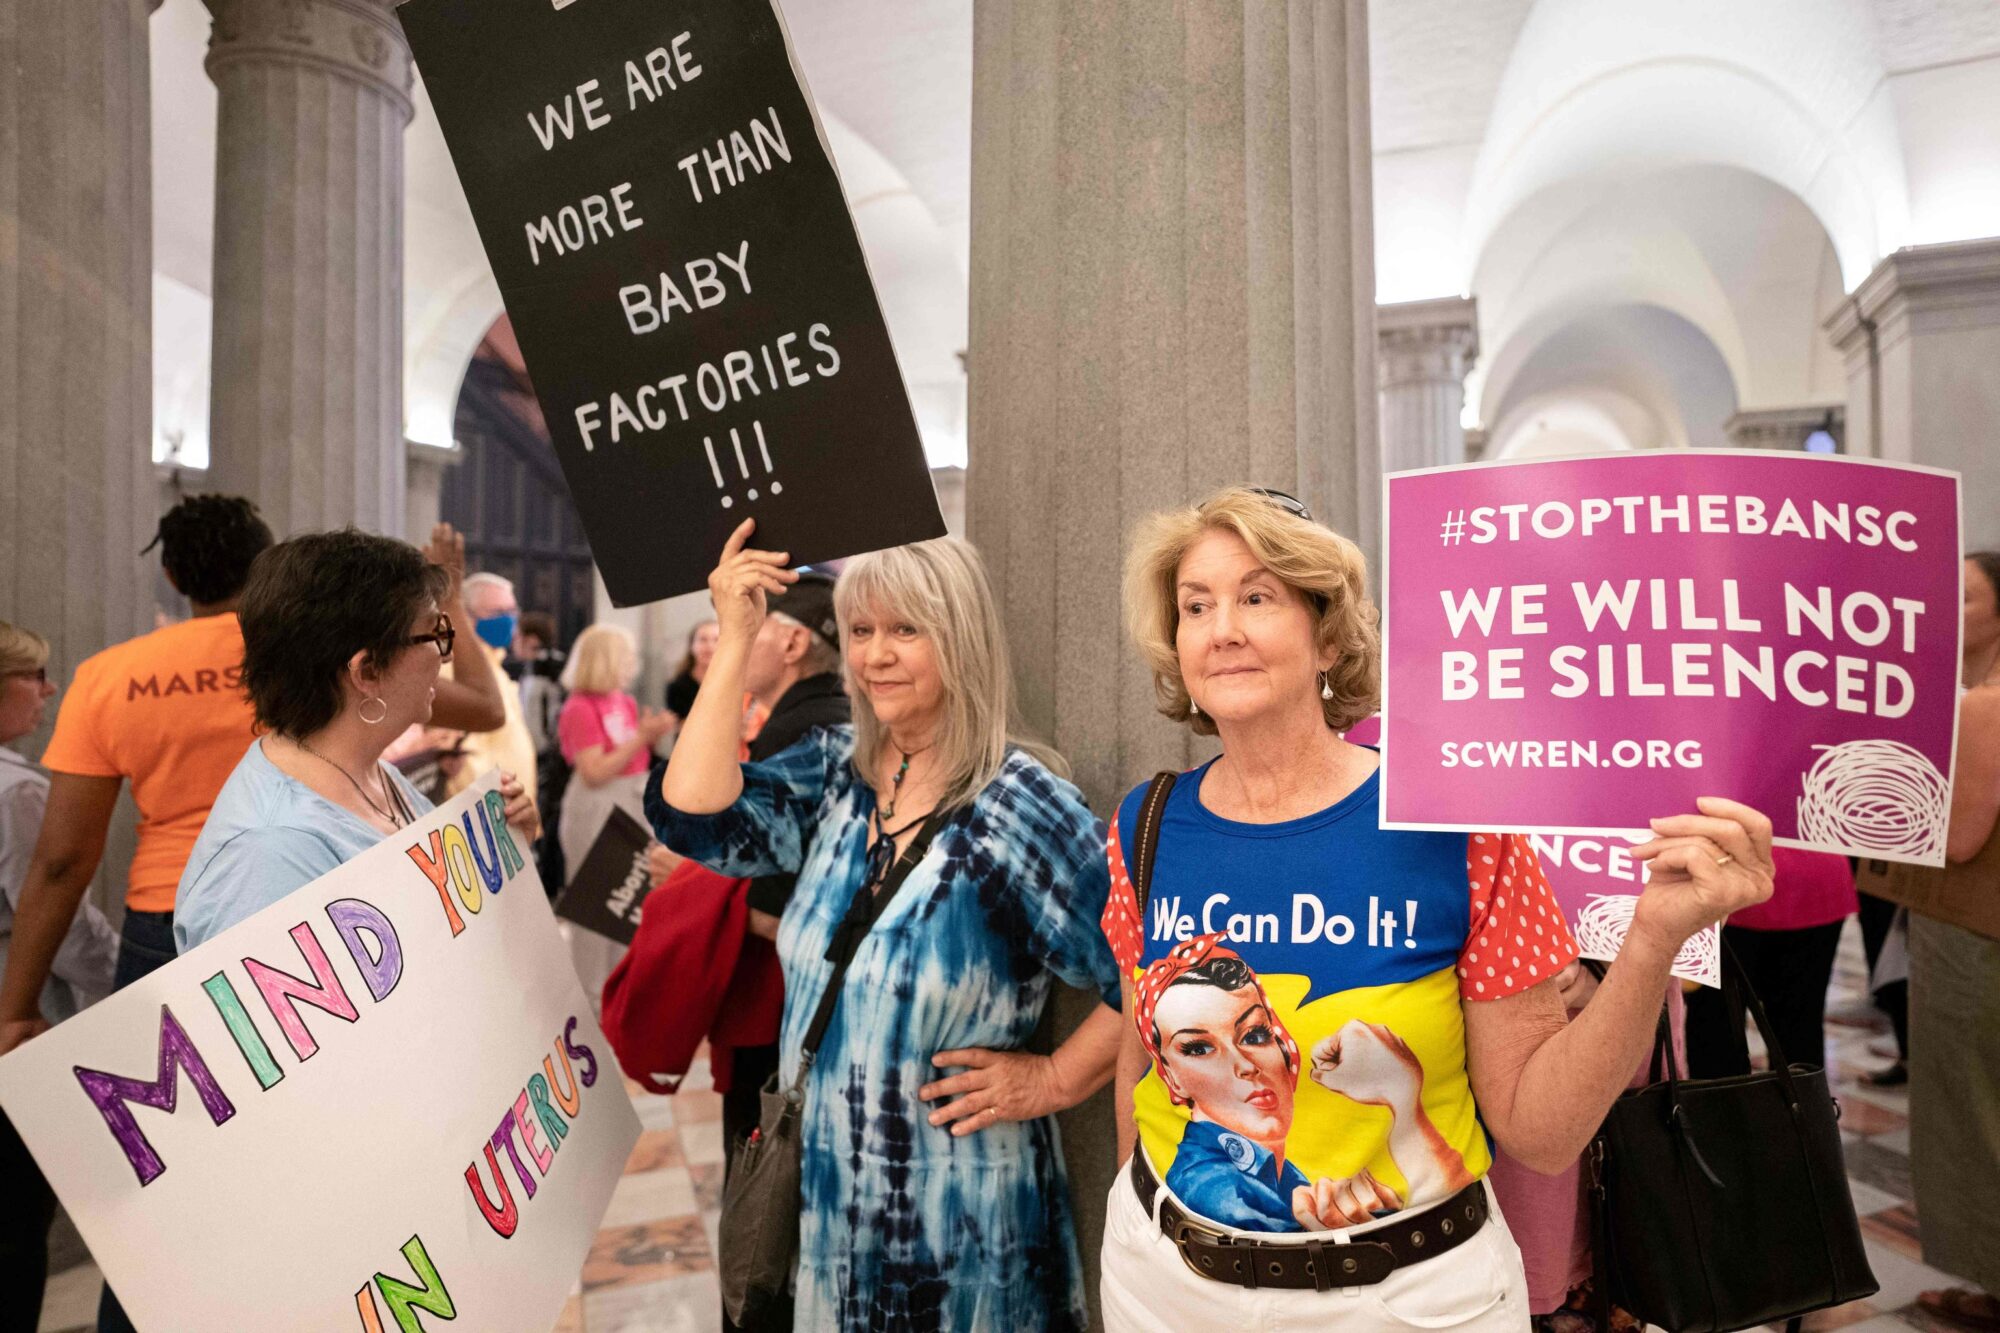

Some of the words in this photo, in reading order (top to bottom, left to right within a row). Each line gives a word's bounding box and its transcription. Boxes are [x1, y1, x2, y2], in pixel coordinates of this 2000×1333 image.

[527, 79, 611, 150] WE
[624, 31, 702, 111] ARE
[525, 182, 643, 265] MORE
[677, 106, 792, 203] THAN
[619, 240, 751, 335] BABY
[575, 323, 841, 451] FACTORIES
[703, 420, 783, 508] !!!
[1440, 495, 1917, 552] #STOPTHEBANSC
[1440, 584, 1547, 638] WE
[1571, 578, 1761, 632] WILL
[1784, 583, 1926, 653] NOT
[1442, 648, 1525, 701] BE
[1550, 643, 1916, 718] SILENCED
[1440, 740, 1702, 768] SCWREN.ORG
[1531, 835, 1652, 884] NCE
[1152, 895, 1196, 942] We
[1202, 893, 1279, 943] Can
[1291, 893, 1355, 945] Do
[1368, 895, 1418, 949] It!
[73, 898, 404, 1187] MIND
[405, 789, 525, 938] YOUR
[464, 1016, 598, 1239] UTERUS
